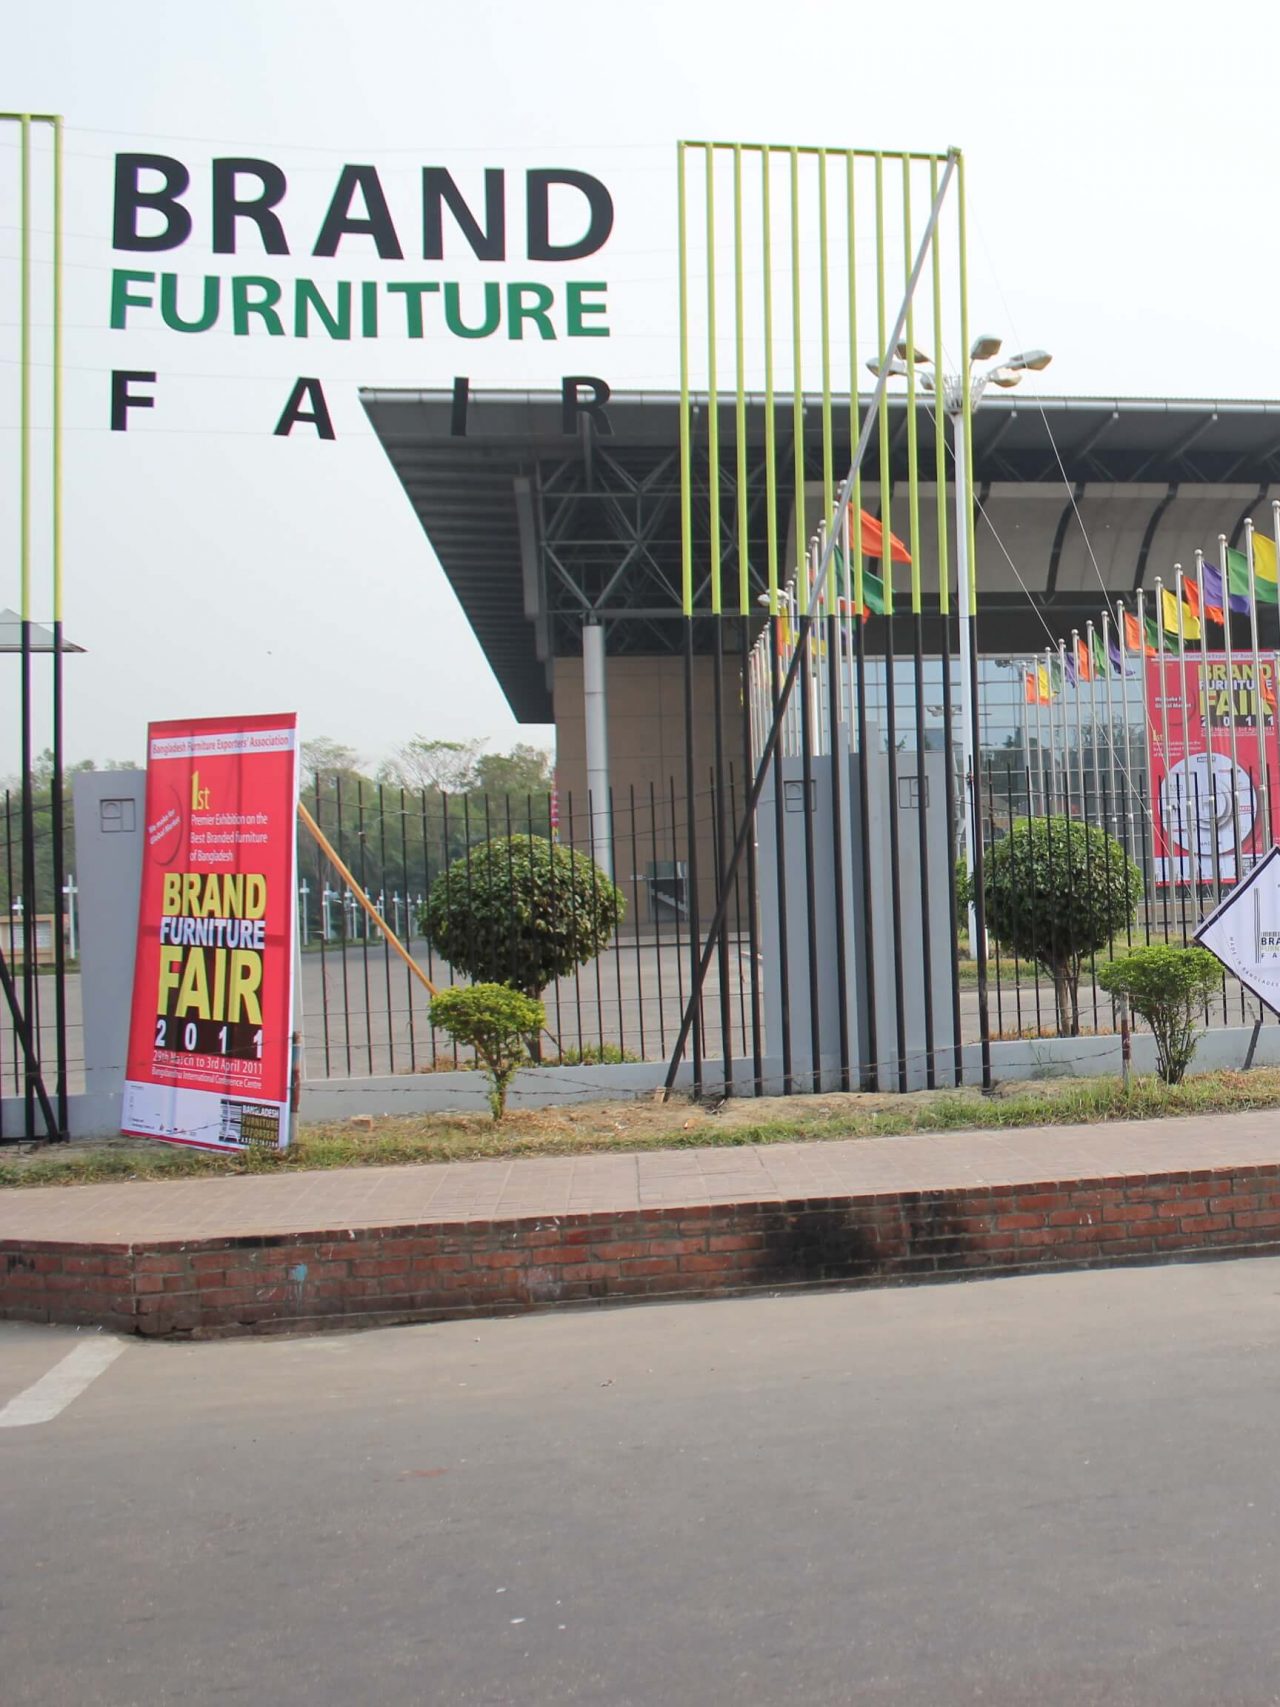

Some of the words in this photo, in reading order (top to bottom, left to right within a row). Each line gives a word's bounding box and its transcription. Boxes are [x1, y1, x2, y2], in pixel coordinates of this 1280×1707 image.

[112, 153, 614, 262] BRAND
[110, 268, 611, 340] FURNITURE
[110, 369, 615, 440] FAIR
[1198, 664, 1272, 680] BRAND
[1199, 680, 1273, 690] FURNITUE
[152, 741, 187, 756] Bangladesh
[188, 740, 216, 752] Furniture
[250, 734, 289, 747] Association
[191, 770, 211, 810] 1st
[191, 814, 215, 826] Premier
[246, 815, 256, 825] on
[256, 812, 268, 825] the
[191, 832, 205, 843] Best
[206, 831, 235, 843] Branded
[190, 849, 198, 861] of
[198, 849, 234, 864] Bangladesh
[162, 873, 267, 919] BRAND
[160, 917, 266, 949] FURNITURE
[157, 945, 263, 1025] FAIR
[154, 1019, 262, 1058] 2011
[196, 1057, 205, 1066] to
[207, 1056, 219, 1069] 3rd
[220, 1058, 240, 1072] April
[242, 1061, 263, 1075] 2011
